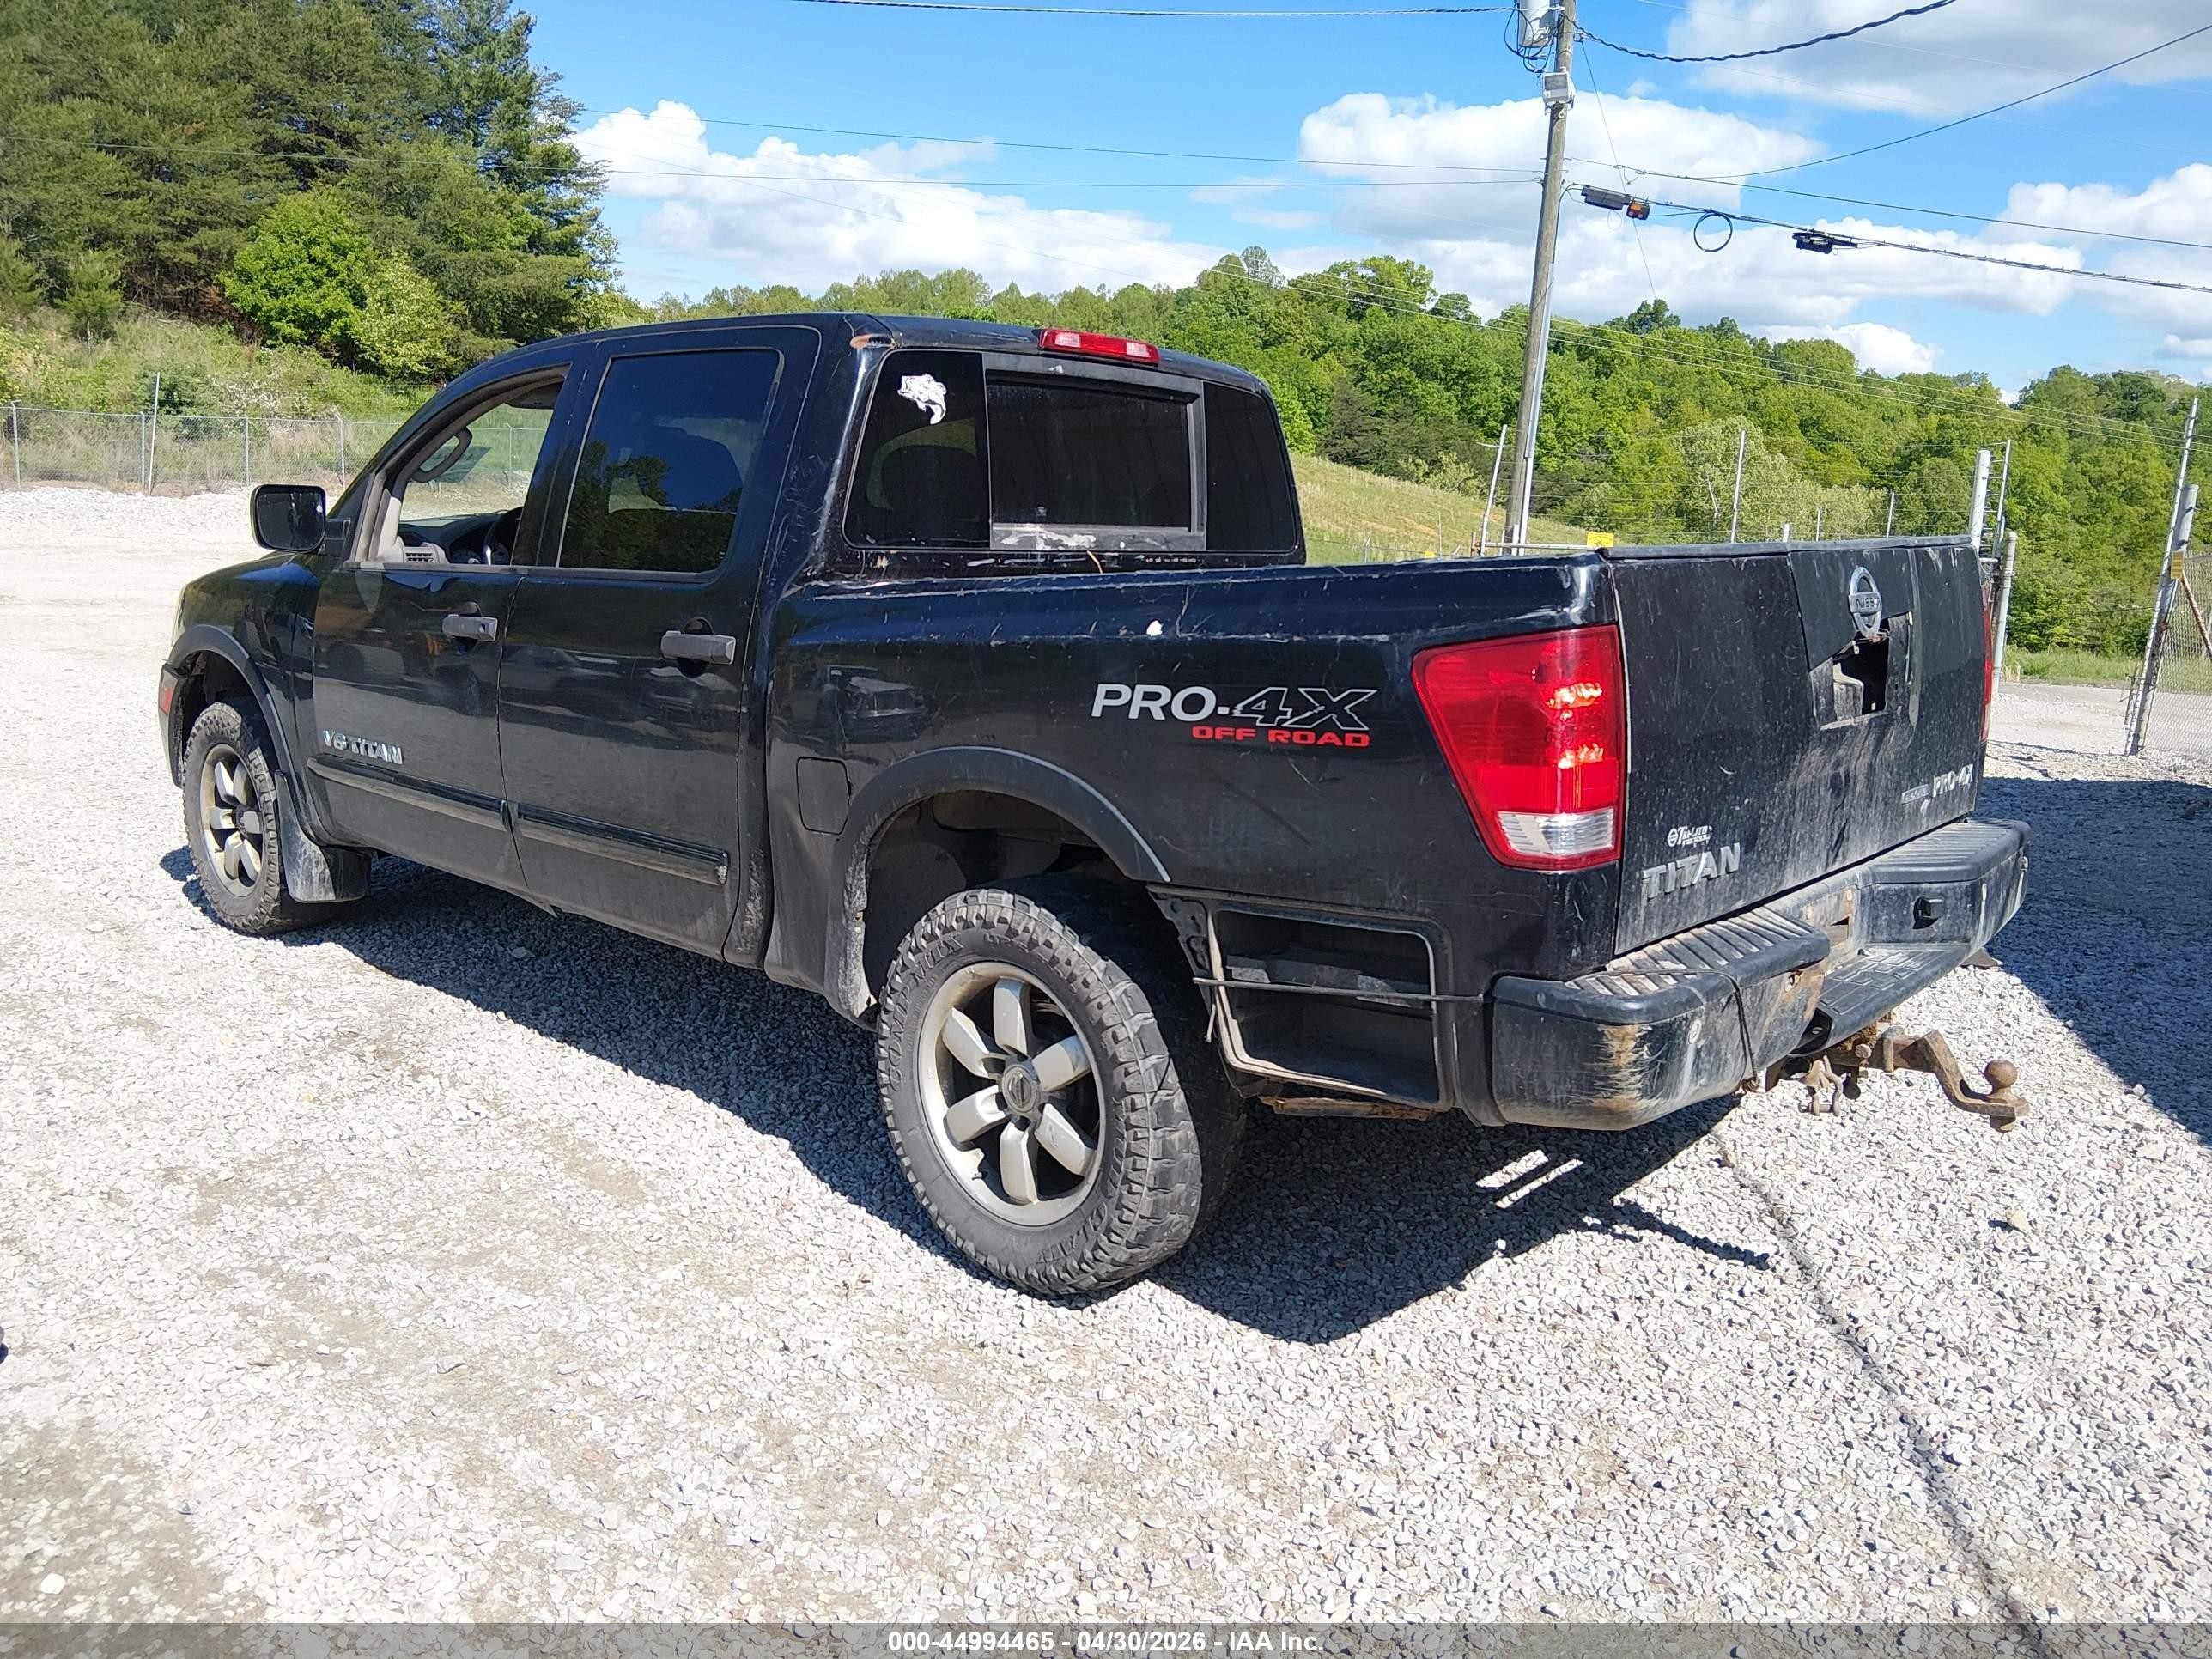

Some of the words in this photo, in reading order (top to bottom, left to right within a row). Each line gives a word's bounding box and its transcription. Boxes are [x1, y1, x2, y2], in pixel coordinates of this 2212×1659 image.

[1856, 597, 1880, 609] NISS
[1192, 726, 1256, 741] OFF
[1268, 729, 1370, 747] ROAD
[349, 735, 404, 765] TITAN
[1641, 842, 1741, 901] TITAN
